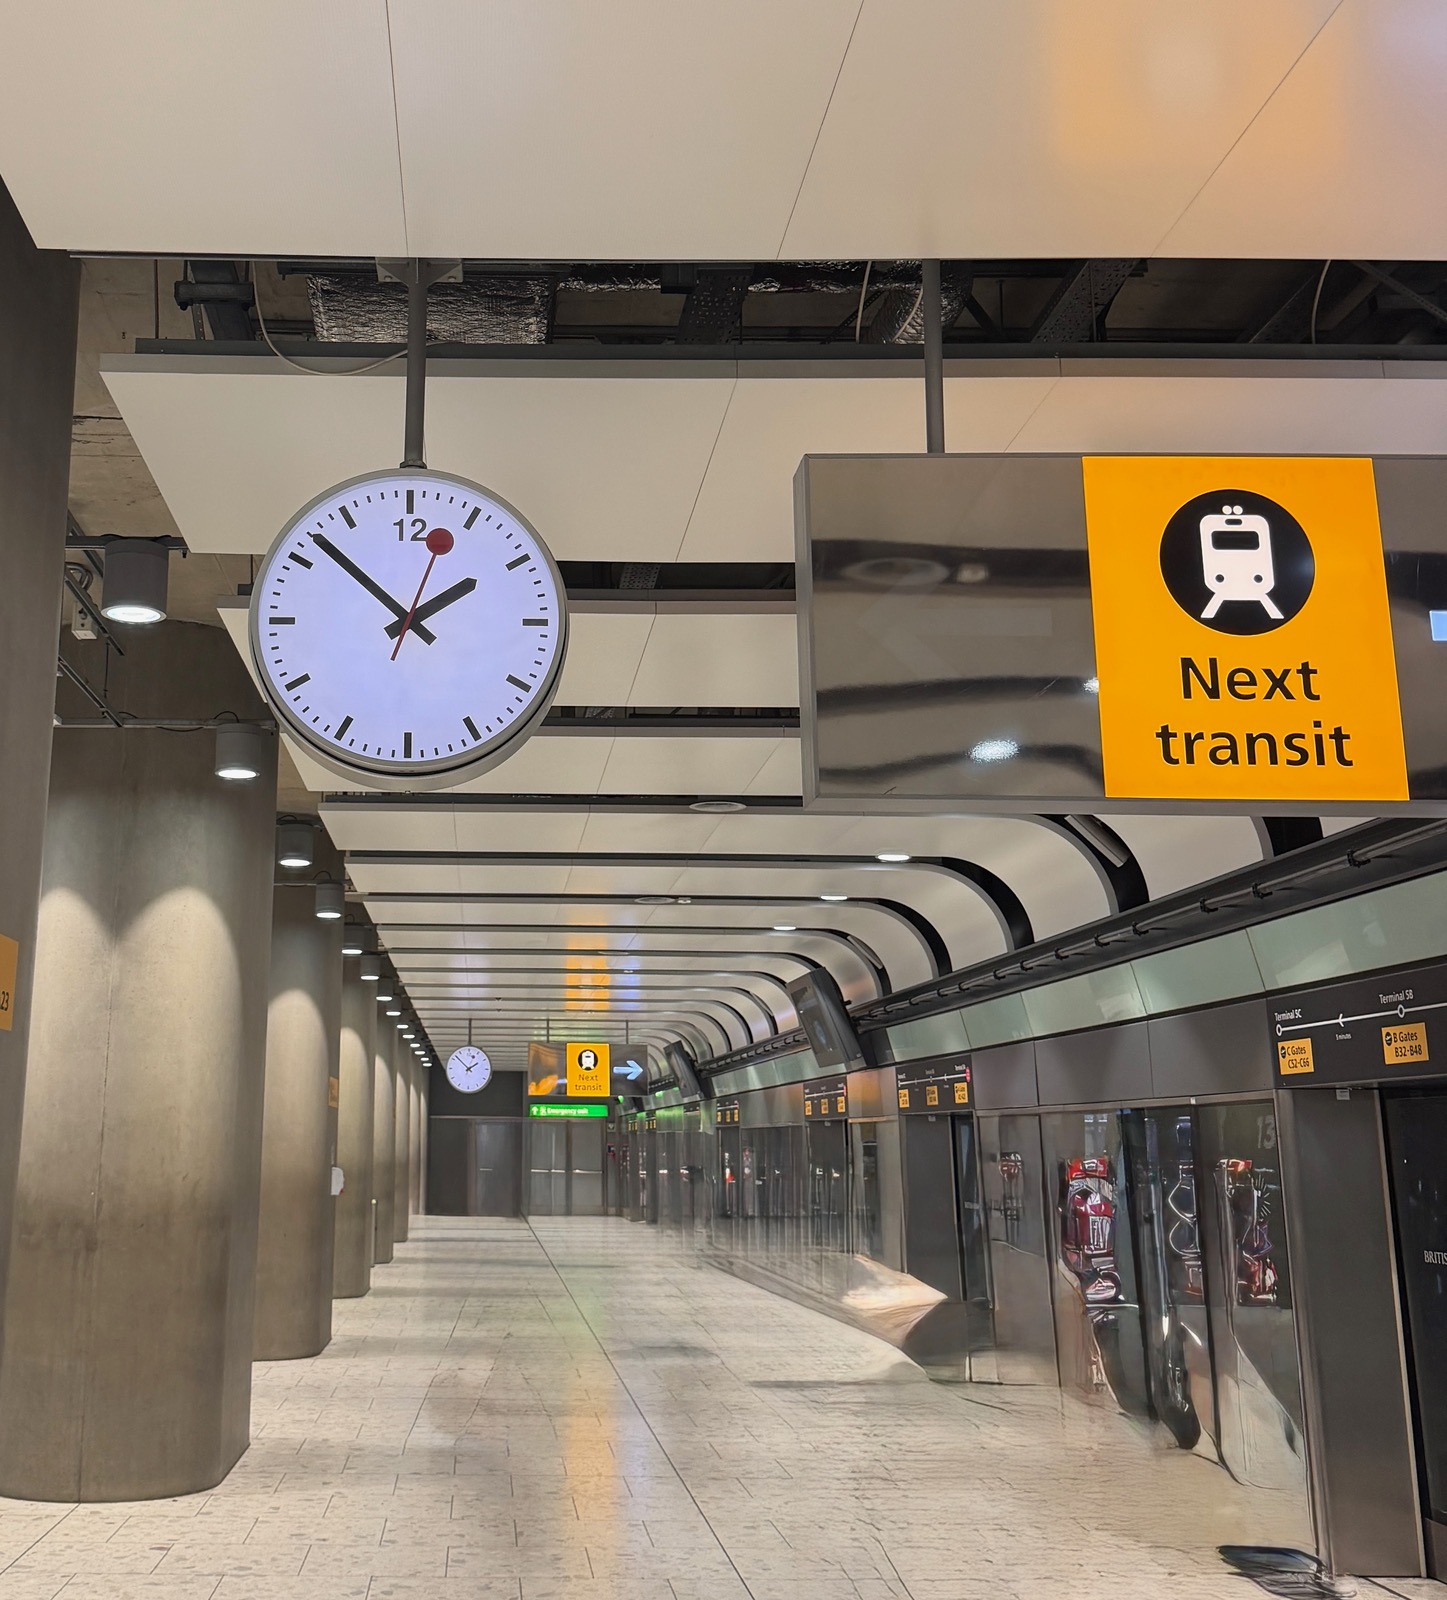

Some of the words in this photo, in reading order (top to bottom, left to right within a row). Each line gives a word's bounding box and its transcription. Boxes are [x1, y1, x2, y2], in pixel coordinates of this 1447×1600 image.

[393, 518, 428, 541] 12
[1180, 657, 1320, 701] Next
[1155, 720, 1353, 767] transit
[1379, 990, 1404, 1004] Terminal
[1405, 989, 1414, 1000] 5B
[1274, 1009, 1295, 1021] Terminal
[1393, 1033, 1398, 1043] B
[1399, 1031, 1418, 1042] Gates
[1286, 1046, 1291, 1056] C
[1291, 1045, 1307, 1055] Gates
[1394, 1044, 1423, 1057] B32-B48
[1287, 1057, 1310, 1069] C52-C66
